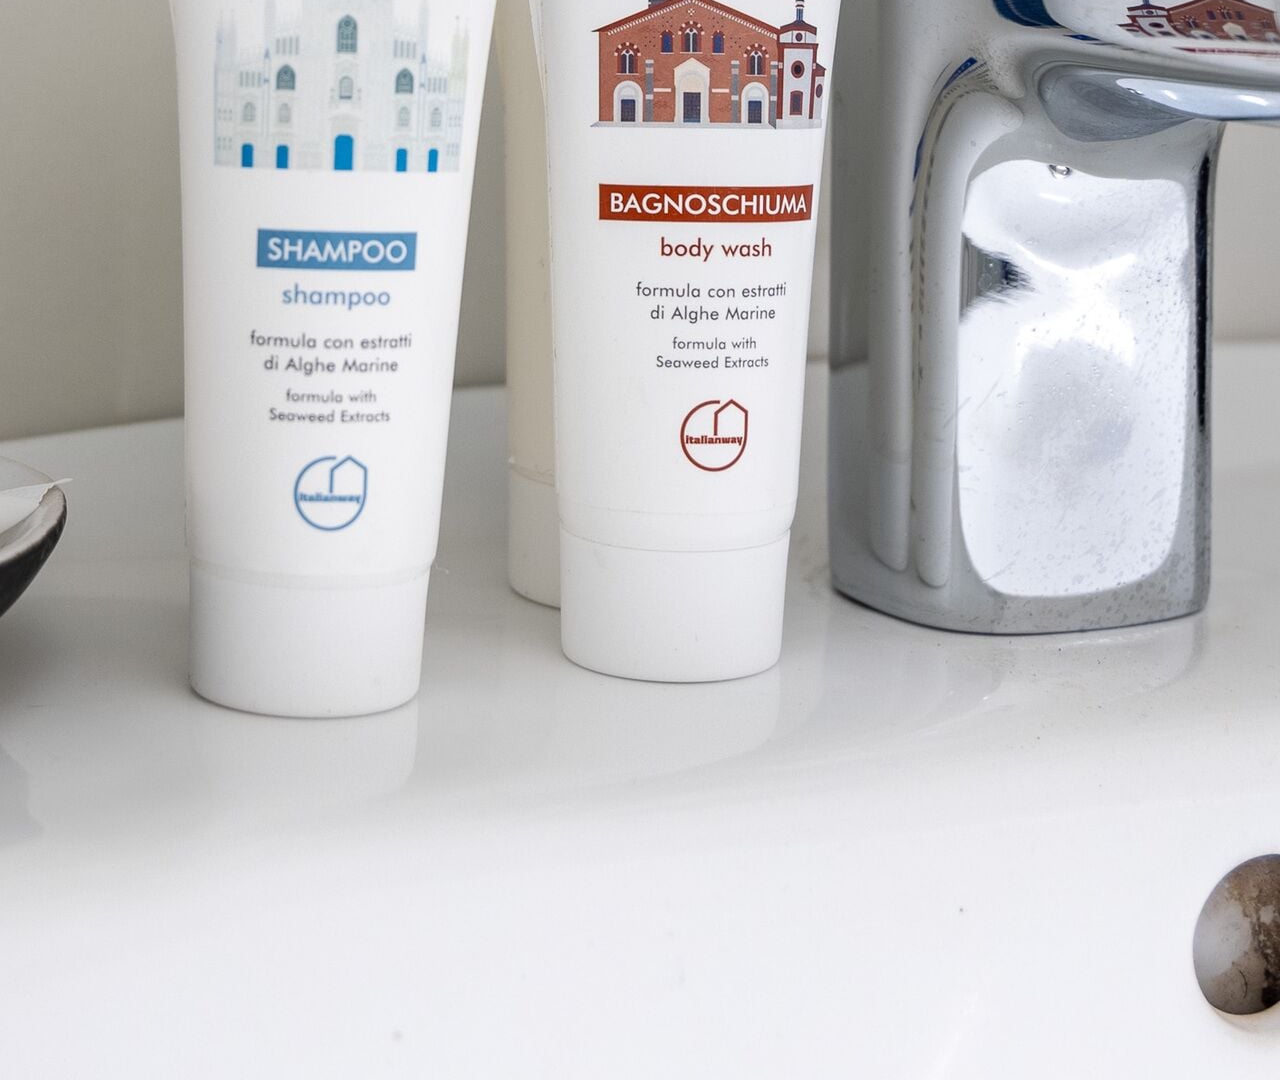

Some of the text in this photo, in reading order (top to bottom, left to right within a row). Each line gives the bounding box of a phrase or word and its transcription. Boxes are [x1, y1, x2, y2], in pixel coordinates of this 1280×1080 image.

[610, 192, 807, 216] BAGNOSCHIUMA
[267, 237, 408, 265] SHAMPOO
[660, 236, 772, 263] body wash
[281, 283, 391, 311] shampoo
[635, 280, 787, 299] formula con estratti
[650, 304, 776, 325] di Alghe Marine
[249, 328, 412, 351] formula con estratti
[671, 336, 757, 351] formula with
[263, 354, 399, 377] di Alghe Marine
[655, 354, 769, 369] Seaweed Extracts
[285, 387, 377, 404] formula with
[268, 407, 391, 424] Seaweed Extracts
[685, 434, 743, 447] italianway
